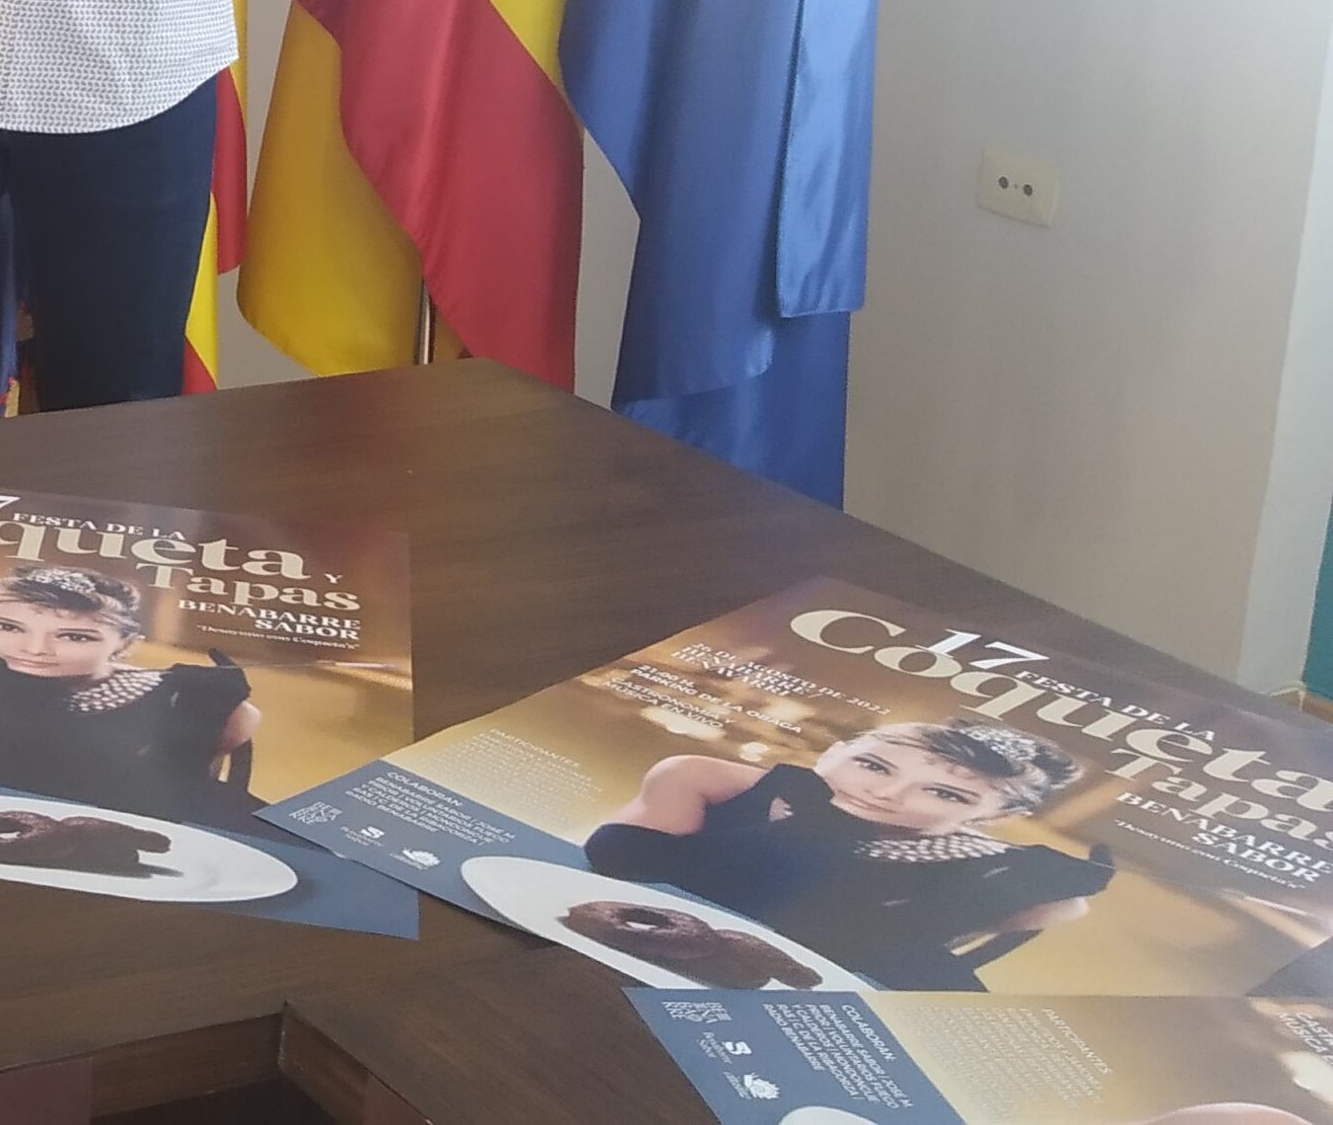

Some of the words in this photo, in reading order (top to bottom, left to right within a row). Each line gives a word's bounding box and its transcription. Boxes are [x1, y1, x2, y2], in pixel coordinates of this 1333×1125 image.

[12, 512, 96, 531] FESTA
[102, 522, 144, 536] DE
[152, 526, 186, 541] LA
[135, 562, 361, 611] Tapas
[324, 573, 343, 584] Y
[178, 599, 361, 630] BENABARRE
[254, 618, 360, 641] SABOR
[818, 685, 844, 700] DE
[915, 628, 1052, 671] 17
[1015, 669, 1113, 710] FESTA
[1118, 703, 1171, 727] DE
[1168, 721, 1215, 742] LA
[629, 668, 699, 696] PARKING
[698, 691, 724, 706] DE
[722, 700, 744, 713] LA
[744, 709, 803, 734] OBAGA
[660, 702, 685, 717] EN
[683, 712, 724, 728] VIVO
[789, 608, 1333, 813] Coqueta
[1115, 791, 1333, 875] BENABARRE
[1191, 830, 1321, 883] SABOR
[857, 1048, 886, 1075] SABOR
